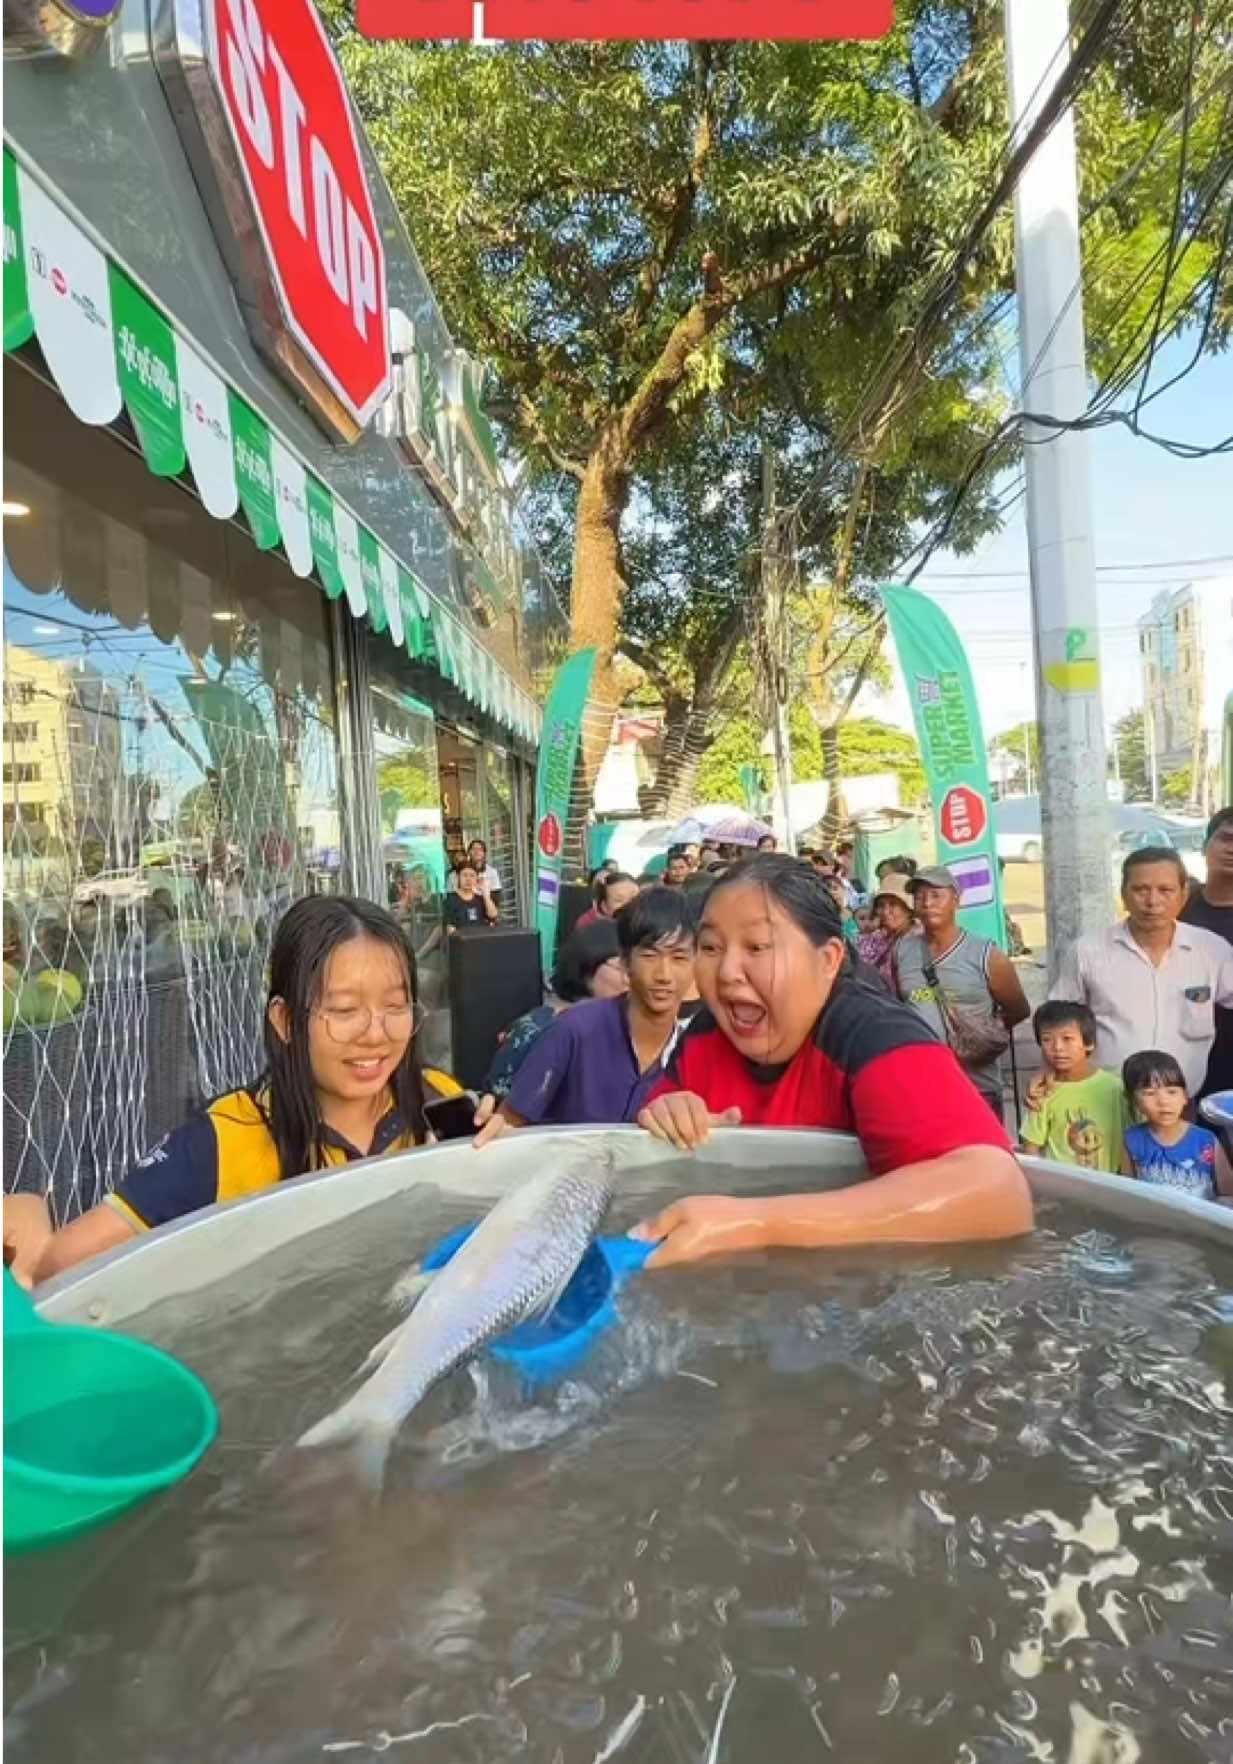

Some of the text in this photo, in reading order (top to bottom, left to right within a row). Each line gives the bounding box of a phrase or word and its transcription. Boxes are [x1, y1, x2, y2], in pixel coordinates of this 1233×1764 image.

[224, 0, 378, 343] STOP
[923, 704, 955, 779] SUPER
[938, 671, 976, 764] MARKET
[949, 793, 972, 840] STOP
